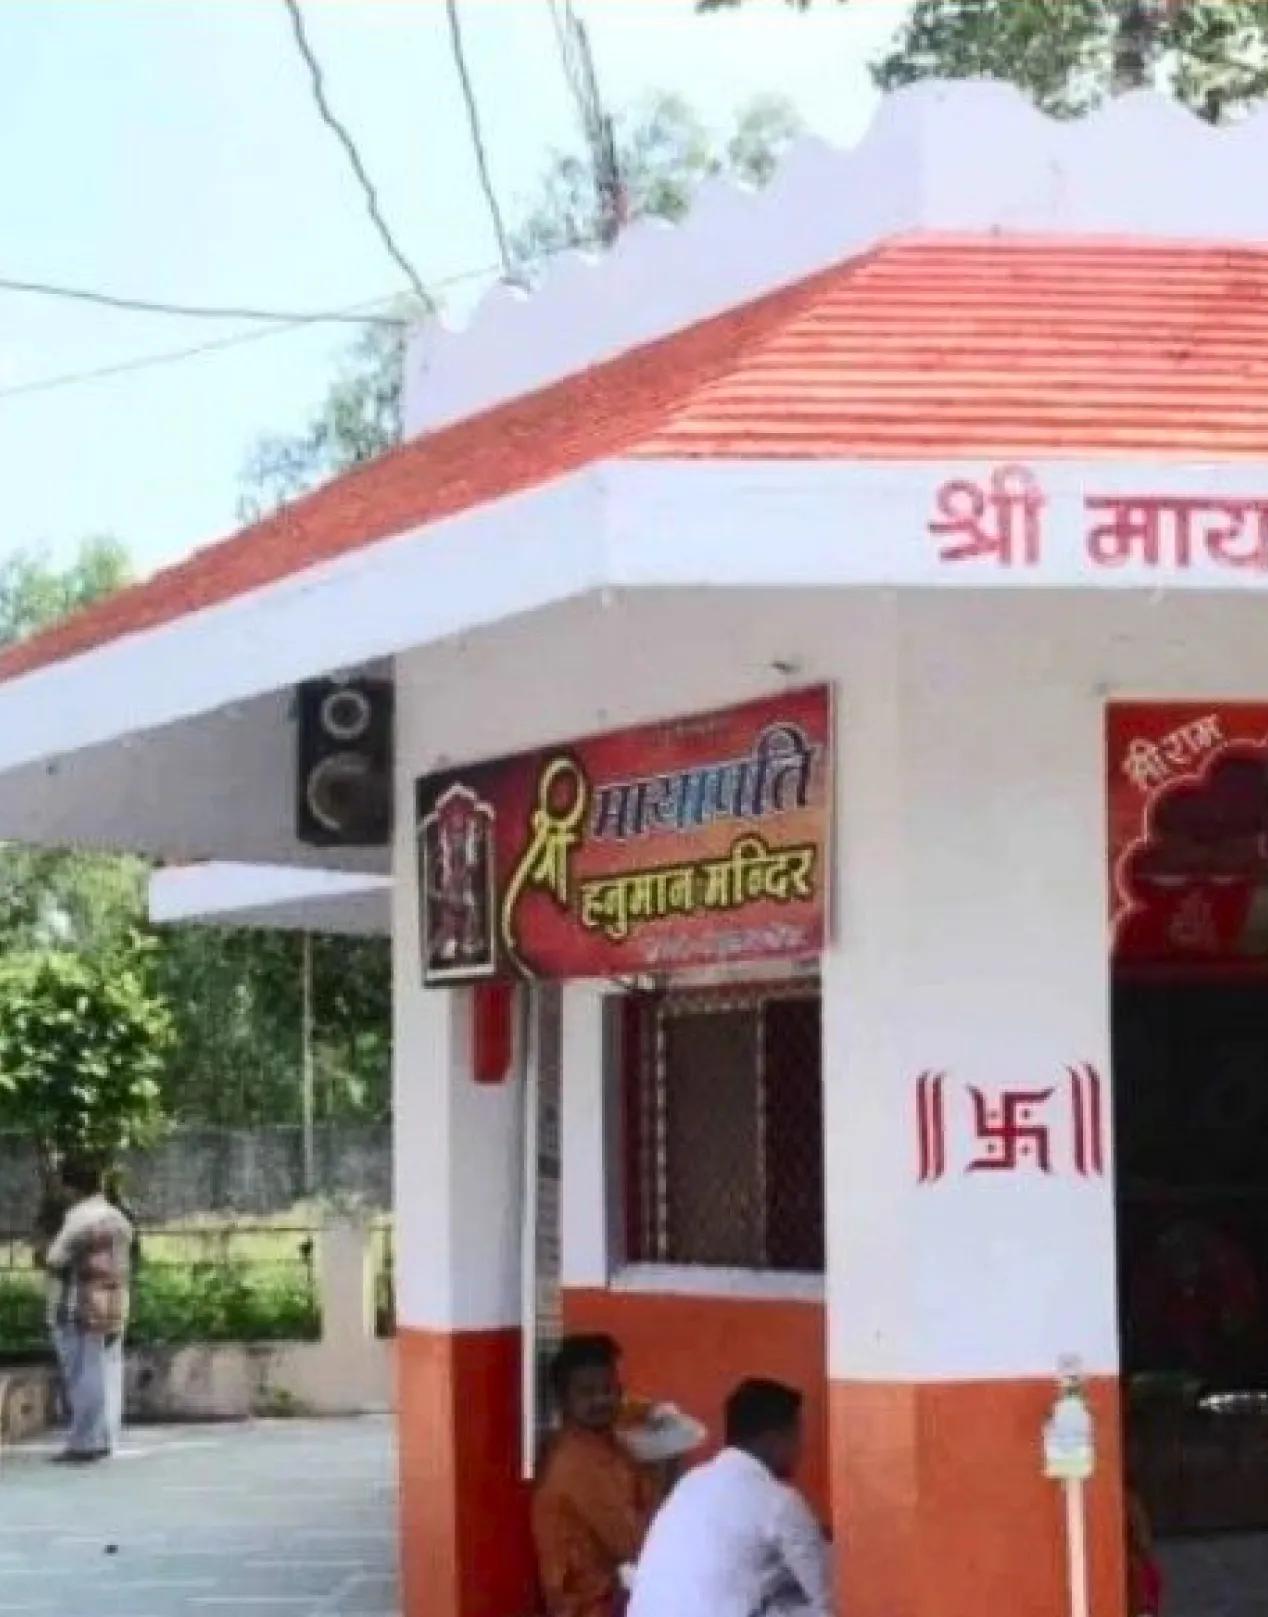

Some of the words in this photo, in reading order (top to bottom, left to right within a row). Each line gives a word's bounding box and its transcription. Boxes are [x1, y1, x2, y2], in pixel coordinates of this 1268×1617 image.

[928, 464, 1043, 566] श्री
[502, 758, 588, 980] श्री
[593, 722, 824, 842] मायापति
[577, 866, 695, 939] हनुमान
[702, 836, 816, 908] मन्दिर
